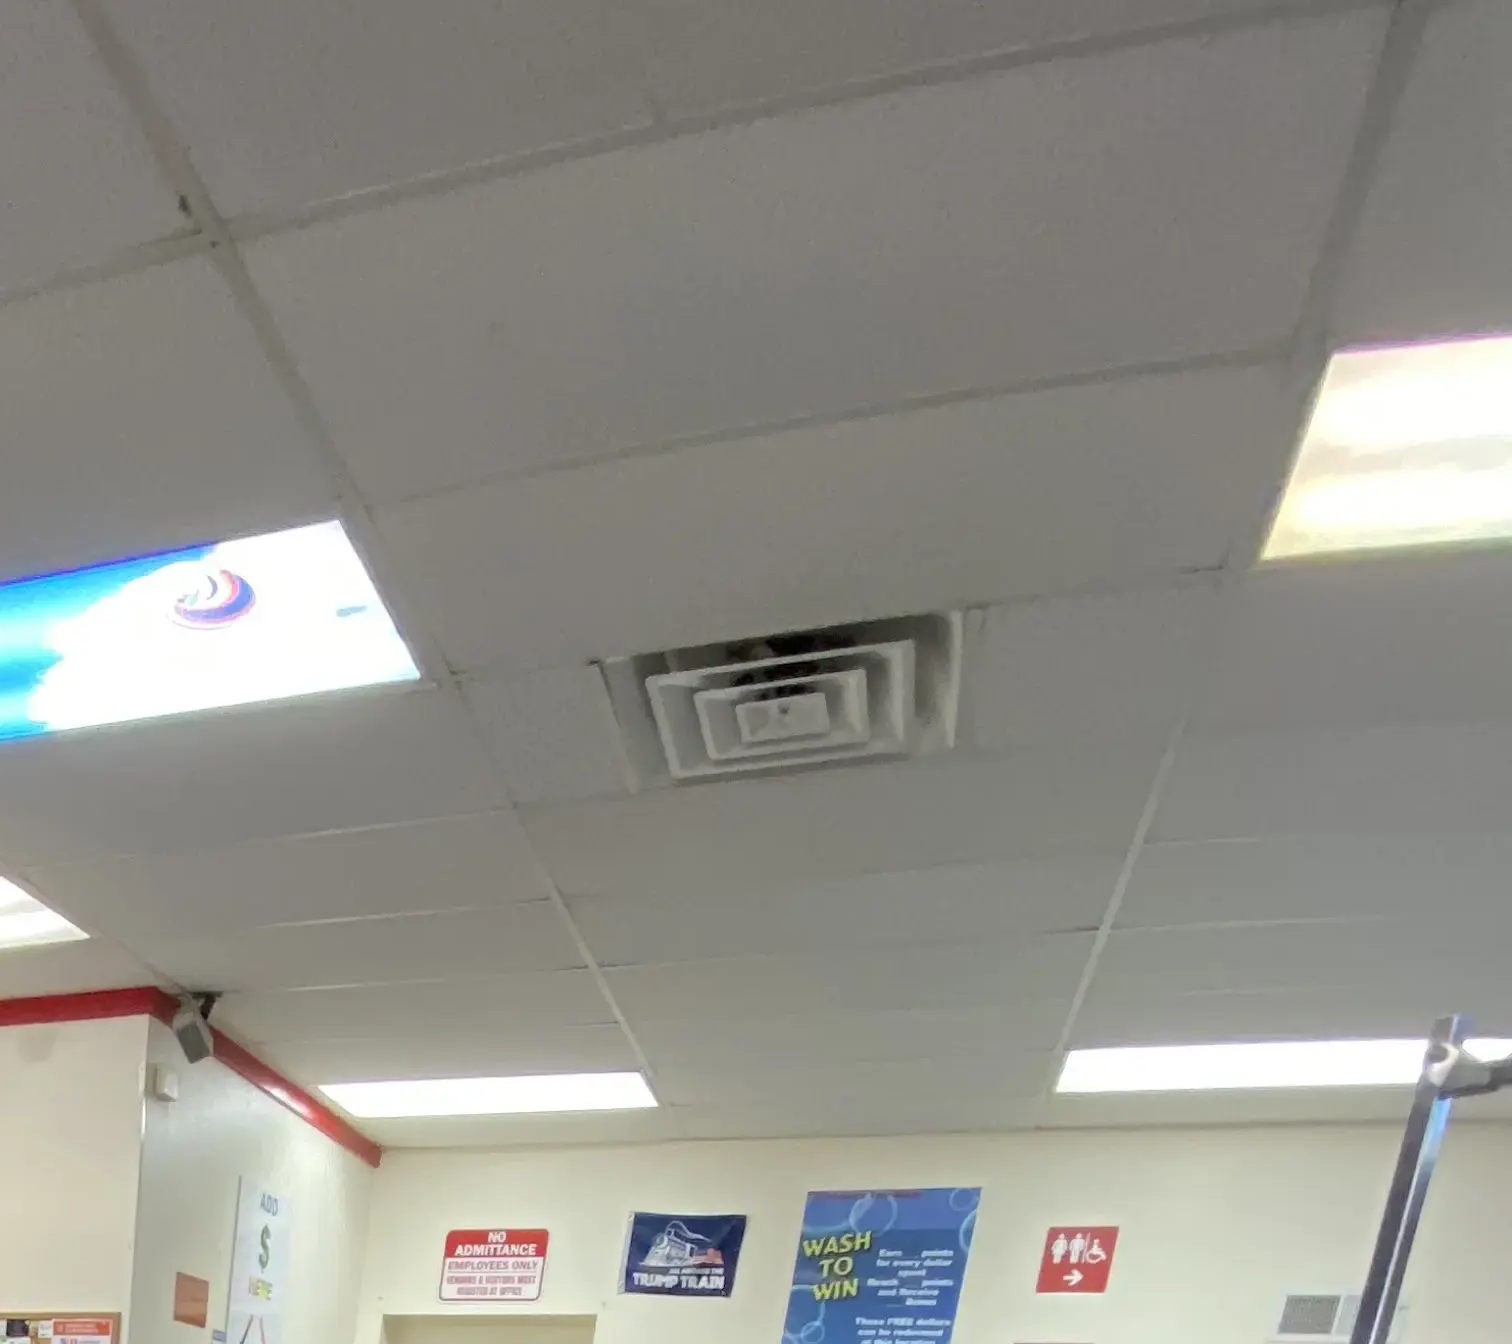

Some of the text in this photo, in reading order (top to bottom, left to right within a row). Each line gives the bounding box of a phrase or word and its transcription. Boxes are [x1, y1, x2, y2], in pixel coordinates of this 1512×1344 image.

[488, 1231, 506, 1243] NO
[802, 1231, 872, 1257] WASH
[454, 1244, 537, 1256] ADMITTANCE
[448, 1260, 539, 1270] EMPLOYEES ONLY
[819, 1257, 853, 1277] TO
[633, 1272, 725, 1290] TRUMP TRAIN
[812, 1279, 859, 1301] WIN
